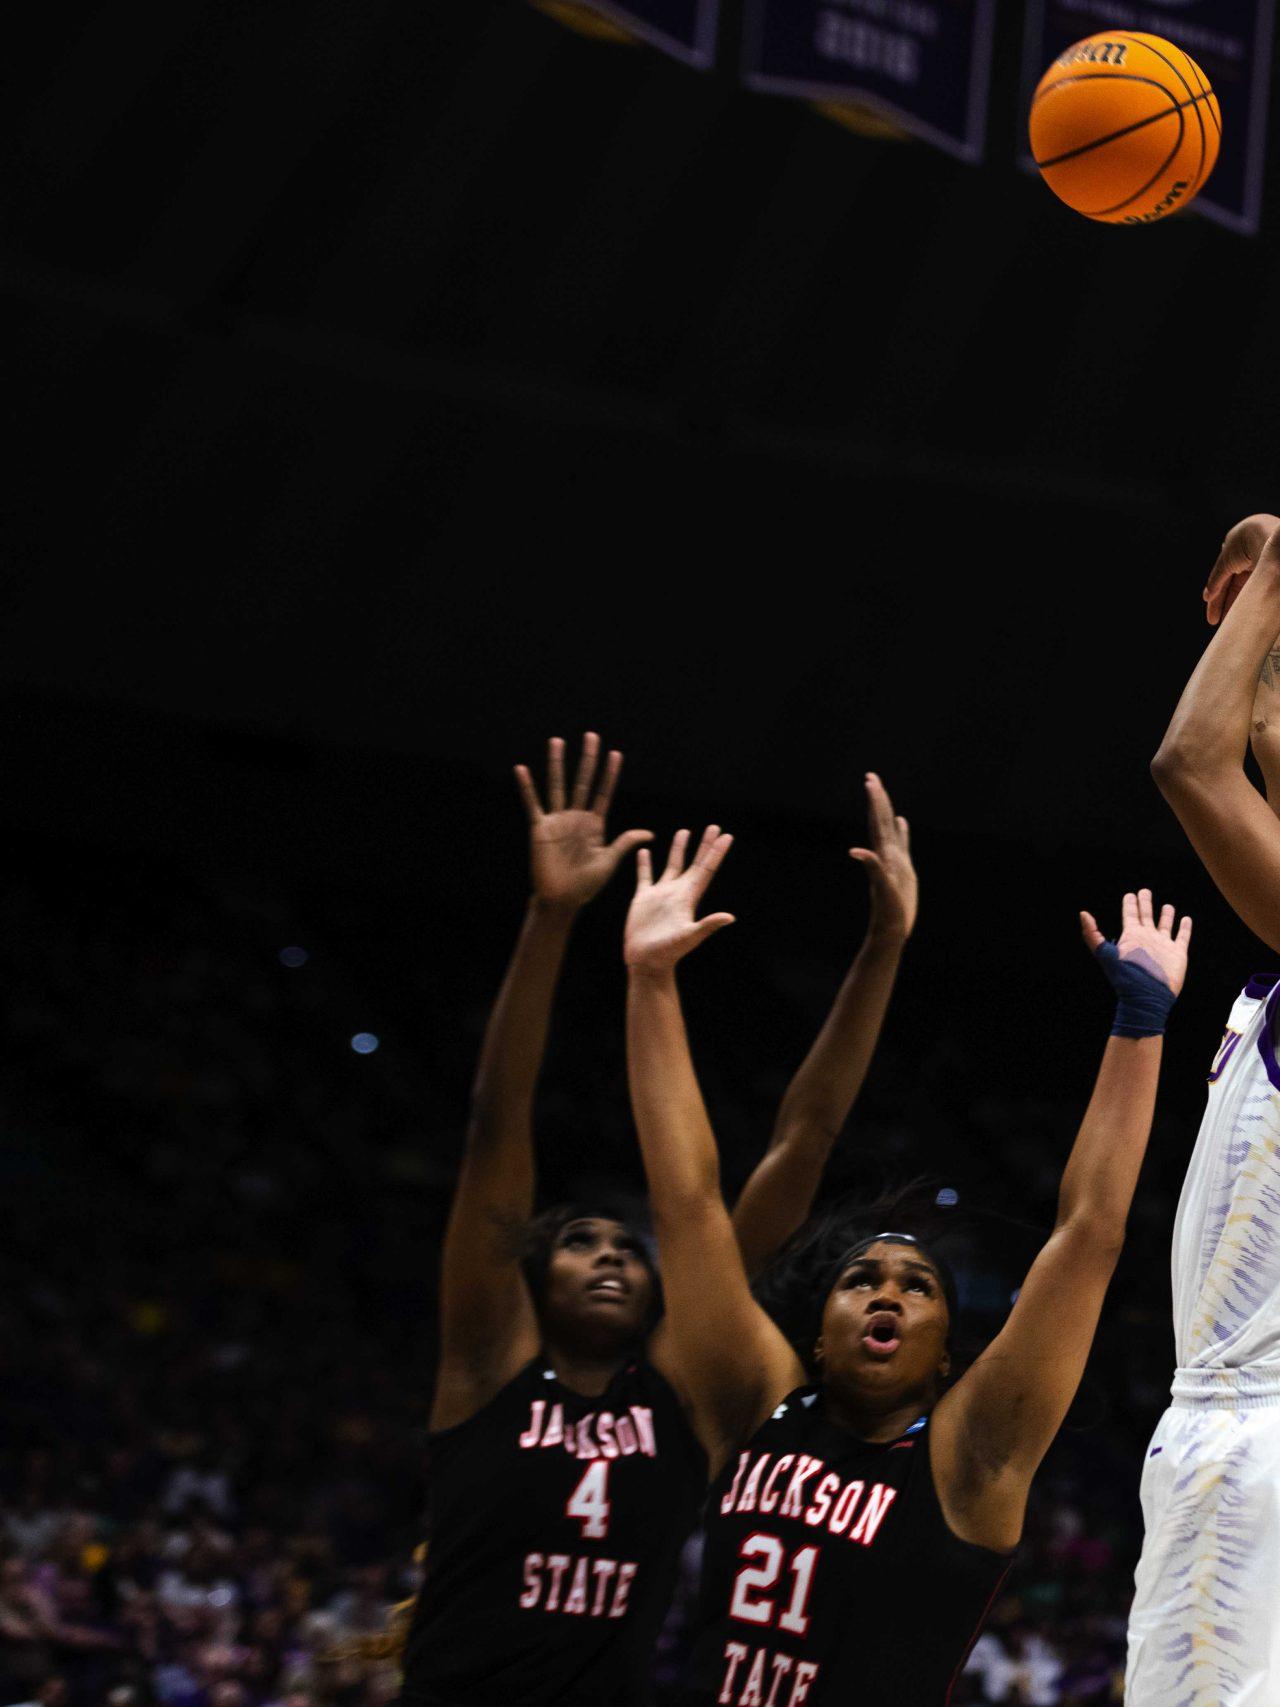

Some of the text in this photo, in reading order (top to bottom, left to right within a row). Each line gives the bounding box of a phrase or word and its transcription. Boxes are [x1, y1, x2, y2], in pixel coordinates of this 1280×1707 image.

[564, 1455, 613, 1542] 4
[719, 1449, 898, 1550] JACKSON
[517, 1549, 640, 1621] STATE
[728, 1530, 822, 1640] 21
